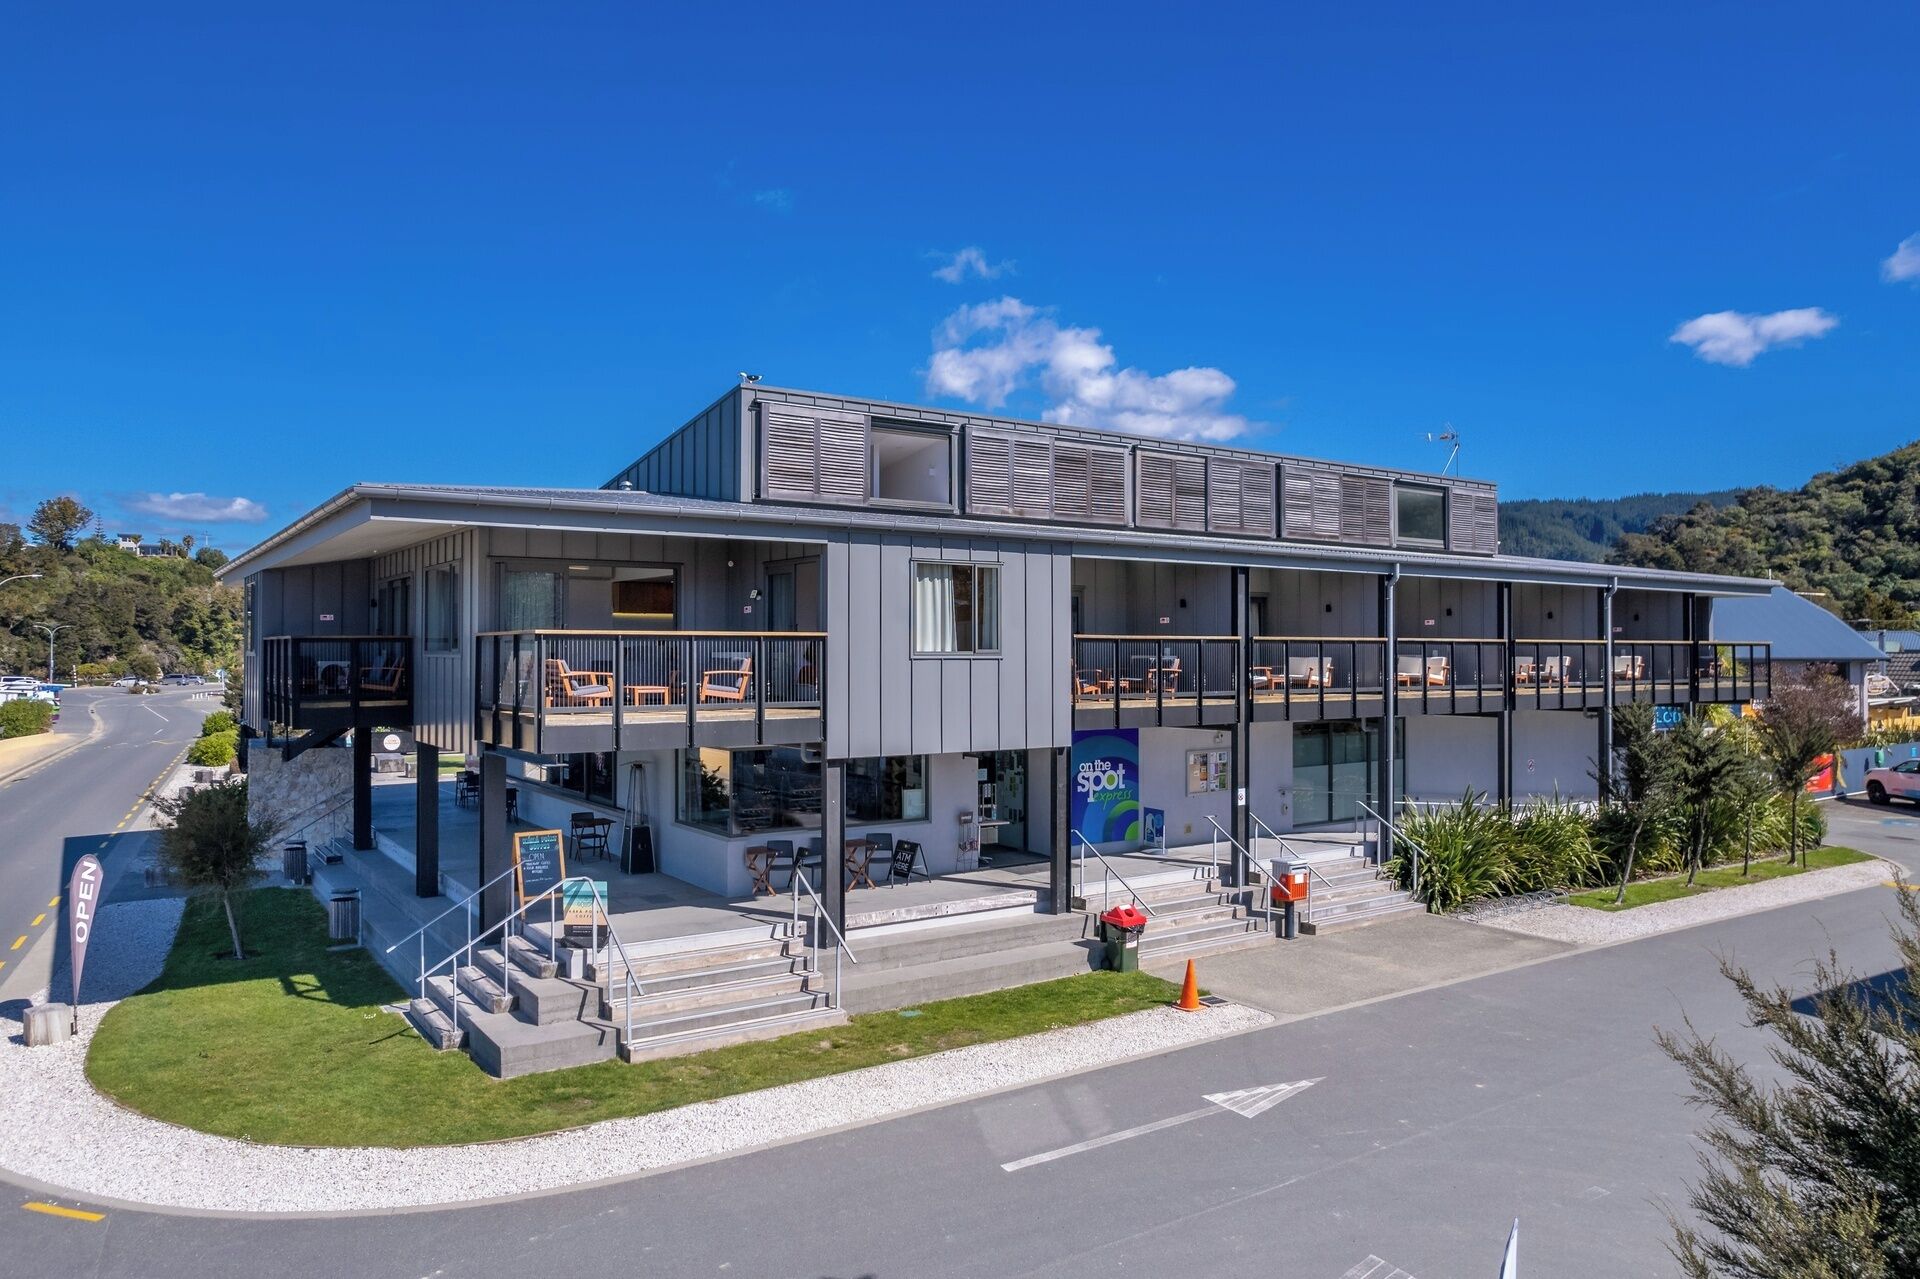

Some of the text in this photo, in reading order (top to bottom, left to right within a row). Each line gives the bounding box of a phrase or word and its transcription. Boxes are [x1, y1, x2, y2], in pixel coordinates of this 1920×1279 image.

[1079, 760, 1112, 772] on the
[1077, 763, 1126, 803] spot
[1093, 789, 1134, 811] express
[896, 852, 912, 863] ATM
[893, 861, 910, 872] HERE
[75, 860, 98, 944] OPEN
